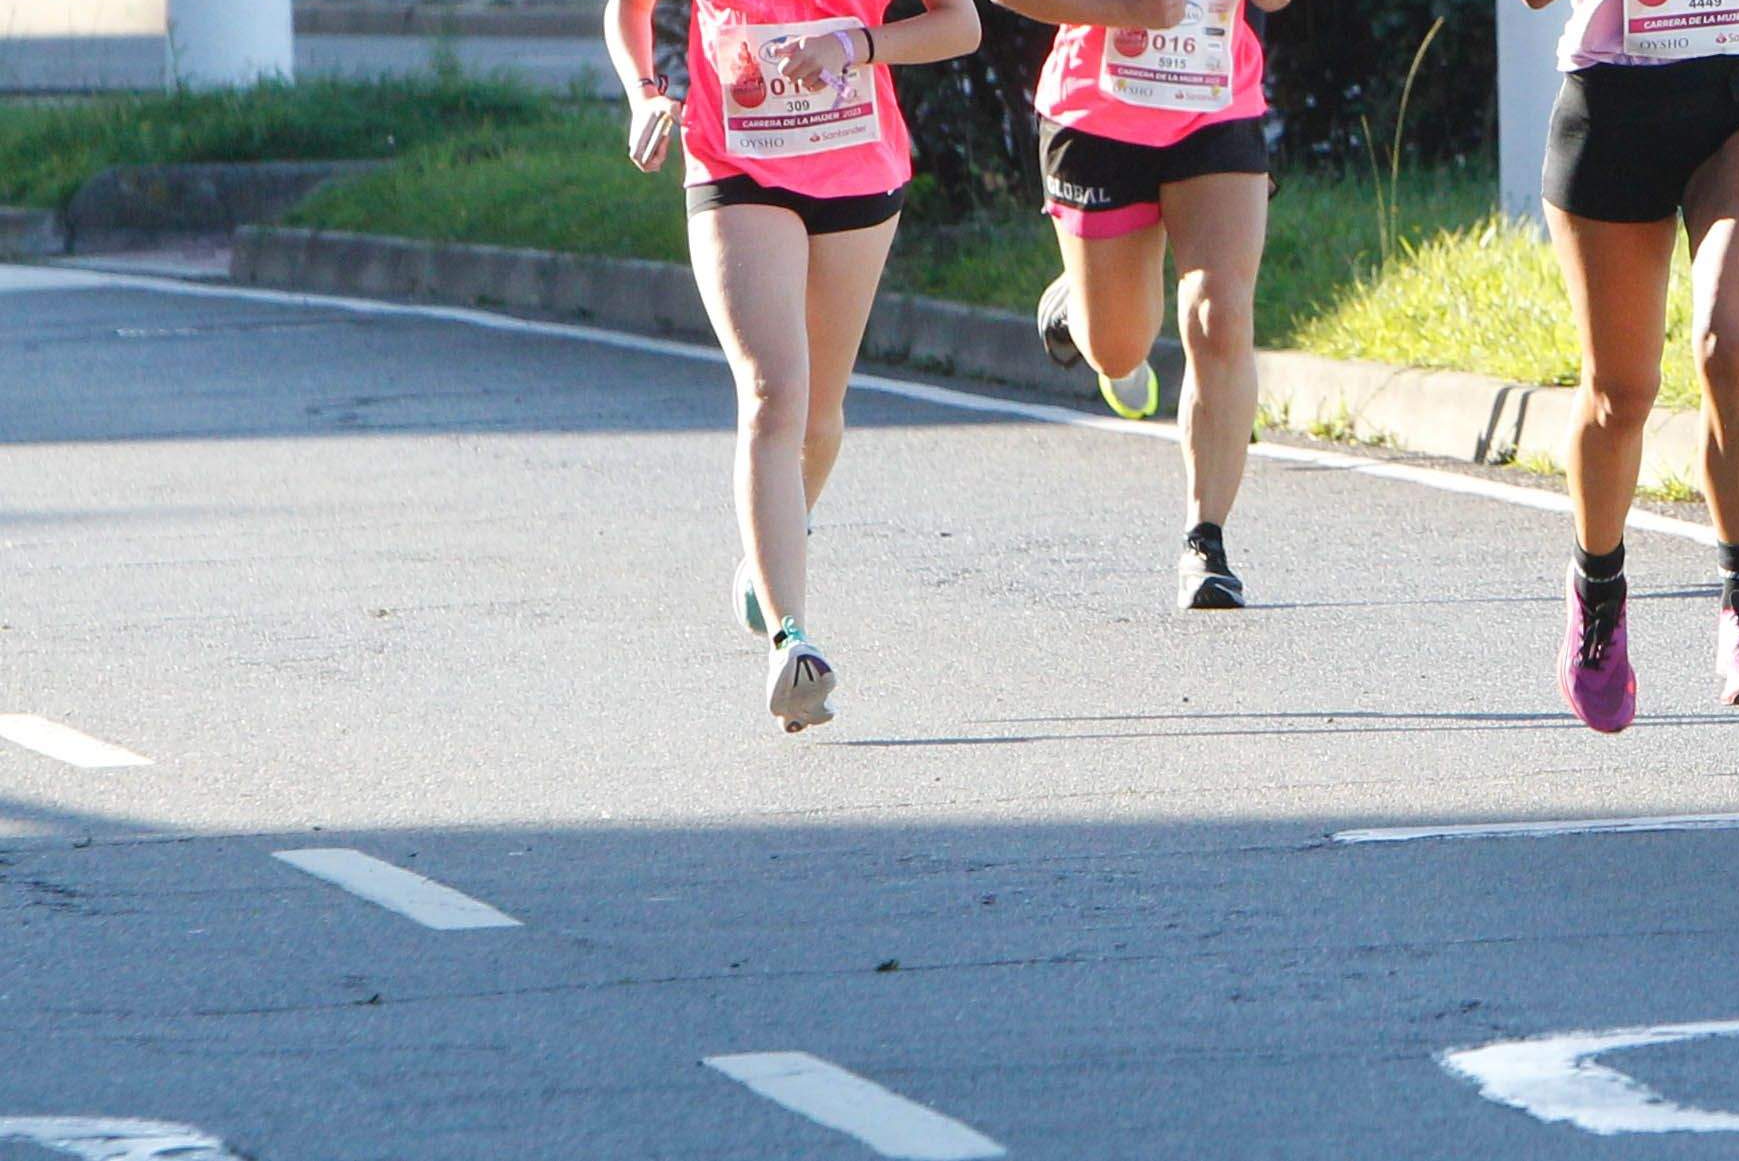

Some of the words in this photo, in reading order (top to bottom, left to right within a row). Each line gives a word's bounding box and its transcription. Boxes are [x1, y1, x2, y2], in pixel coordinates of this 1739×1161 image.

[1643, 16, 1687, 30] CARRERA
[1689, 15, 1700, 25] DE
[1702, 14, 1716, 24] LA
[1152, 34, 1196, 54] 016
[1640, 37, 1689, 51] OYSHO
[1158, 57, 1187, 69] 5915
[787, 100, 810, 113] 309
[742, 118, 782, 129] CARRERA
[783, 118, 796, 127] DE
[797, 116, 809, 125] LA
[740, 138, 785, 149] OYSHO
[1046, 174, 1111, 204] GLOBAL
